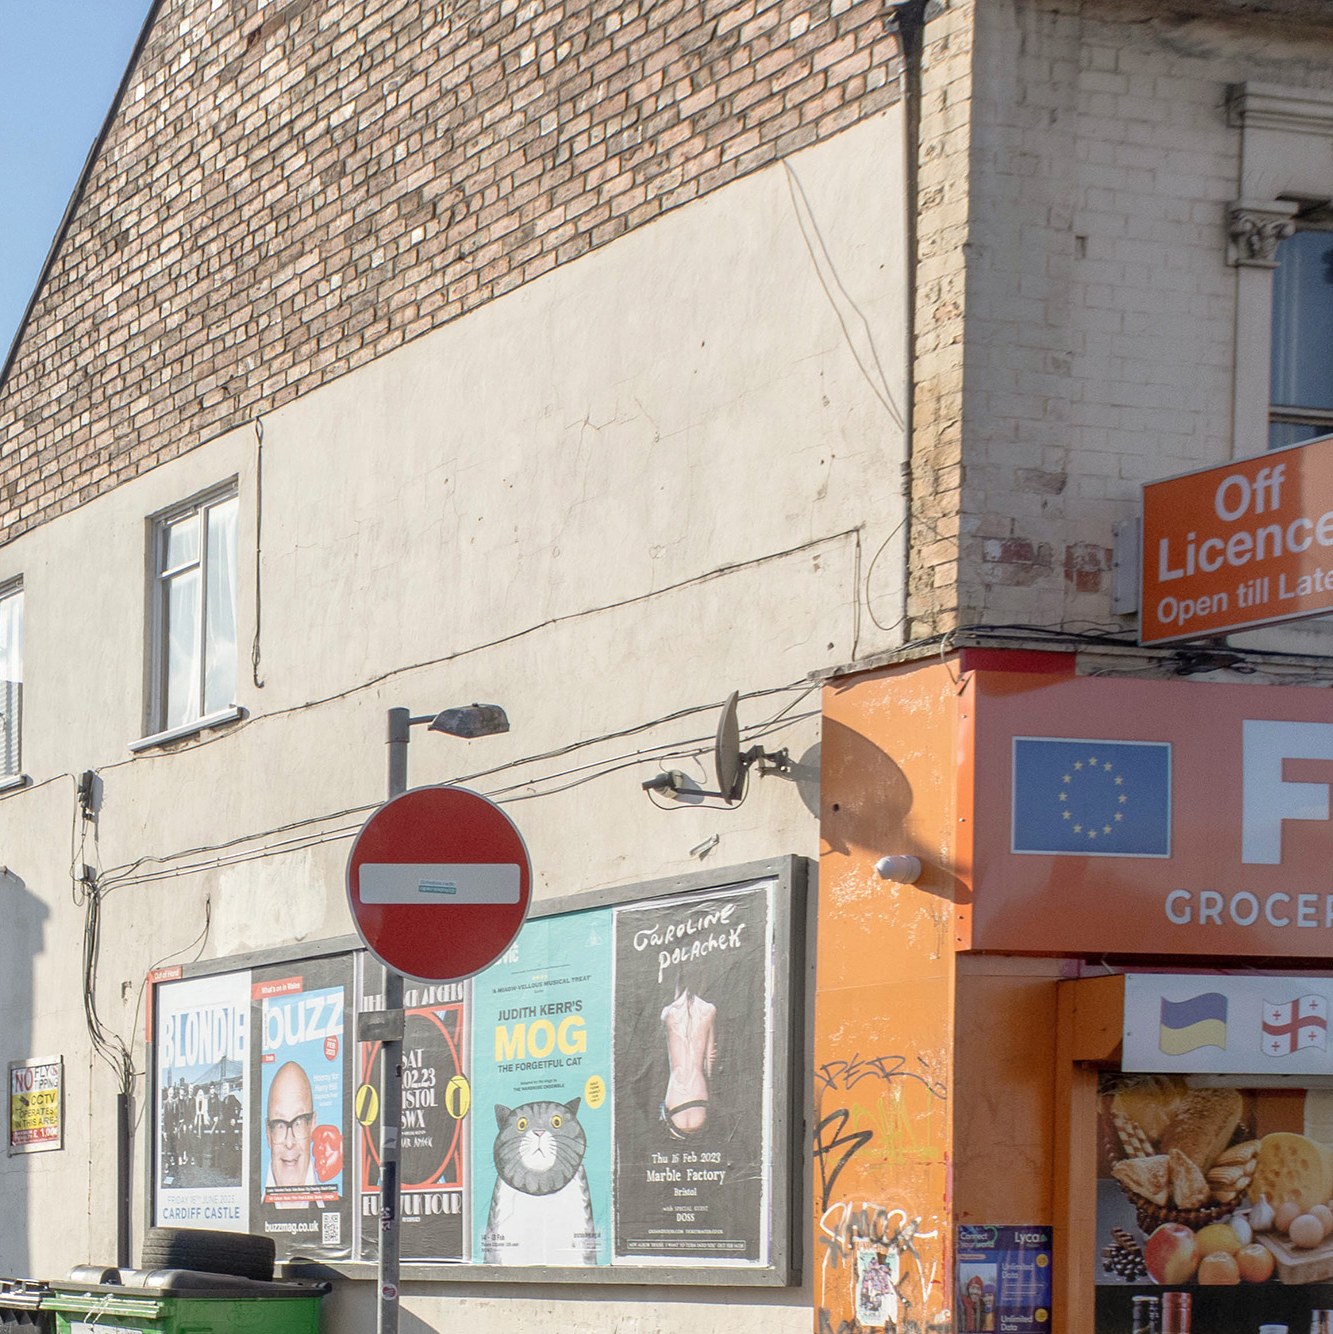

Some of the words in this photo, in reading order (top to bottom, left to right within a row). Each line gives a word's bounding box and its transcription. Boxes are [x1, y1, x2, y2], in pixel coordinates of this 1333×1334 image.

[1215, 463, 1286, 522] Off
[1159, 510, 1333, 582] Licence
[1158, 592, 1228, 626] Open
[1237, 577, 1269, 608] till
[1279, 567, 1333, 600] Late
[498, 1005, 537, 1021] JUDITH
[540, 1000, 583, 1016] KERR'S
[262, 991, 344, 1050] buzz
[161, 1005, 249, 1068] BLONDIE
[494, 1015, 587, 1062] MOG
[498, 1064, 513, 1073] THE
[515, 1059, 563, 1072] FORGETFUL
[566, 1057, 582, 1067] CAT
[15, 1068, 33, 1092] NO
[35, 1066, 50, 1078] FLY
[31, 1093, 55, 1106] CCTV
[19, 1106, 53, 1119] OPERATES
[651, 1153, 668, 1164] Thu
[683, 1152, 697, 1163] Feb
[700, 1152, 721, 1163] 2023
[646, 1168, 681, 1182] Marble
[686, 1169, 726, 1185] Factory
[674, 1188, 697, 1196] Bristol
[424, 1192, 461, 1215] TOUR
[163, 1207, 201, 1219] CARDIFF
[204, 1206, 240, 1219] CASTLE
[676, 1213, 695, 1221] DOSS
[265, 1220, 319, 1235] buzzmag.co.uk
[960, 1232, 987, 1240] Connect
[1014, 1231, 1040, 1244] Lyca
[1002, 1262, 1033, 1271] Unlimited
[1001, 1271, 1018, 1279] Data
[1000, 1315, 1032, 1323] Unlimited
[1000, 1323, 1018, 1331] Data
